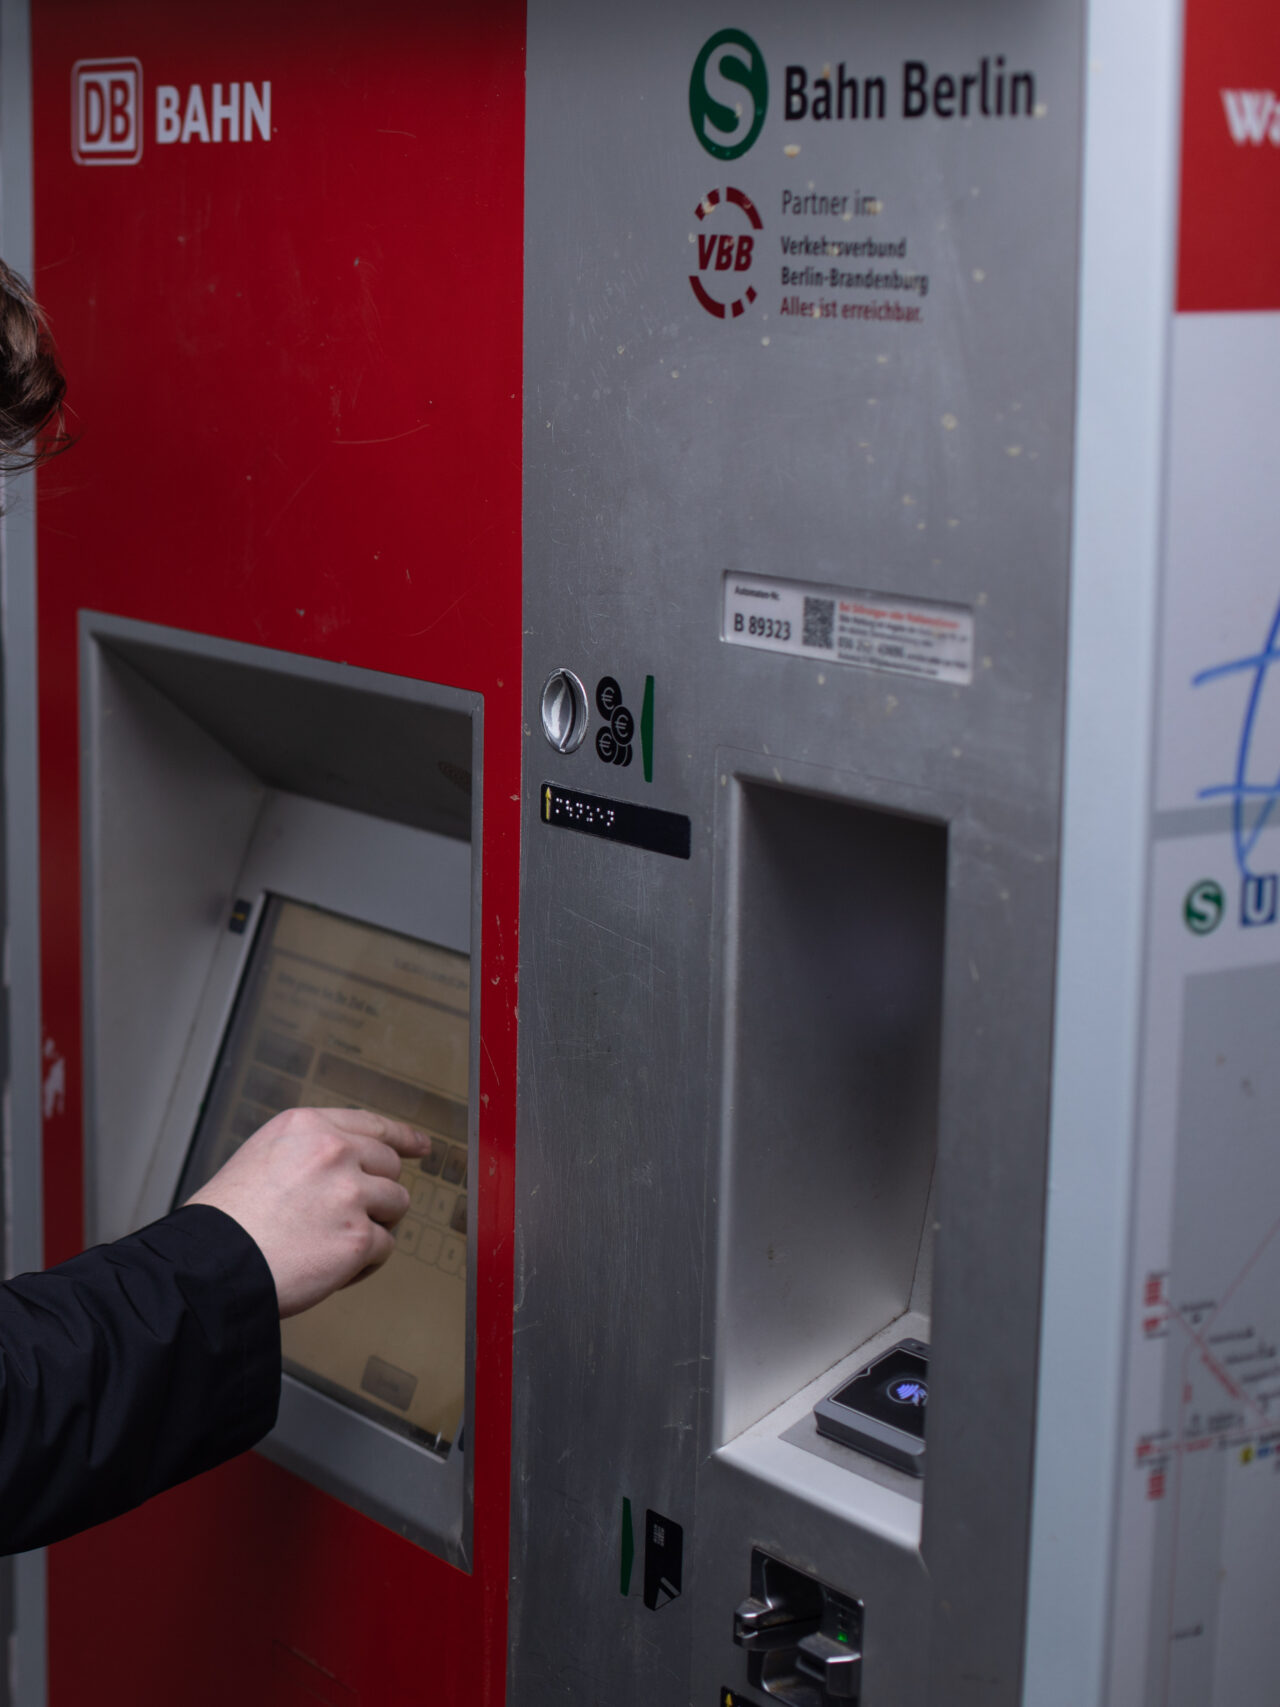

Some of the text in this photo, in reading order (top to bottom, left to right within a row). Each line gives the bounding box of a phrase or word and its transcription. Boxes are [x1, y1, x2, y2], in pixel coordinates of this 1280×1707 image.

[81, 76, 272, 147] DB BAHN
[697, 36, 1035, 154] S Bahn Berlin
[782, 190, 848, 215] Partner
[698, 234, 754, 272] VBB
[781, 266, 929, 297] Berlin-Brandenburg
[780, 296, 817, 317] Alles
[734, 612, 791, 641] B 89323
[1188, 877, 1275, 933] S U
